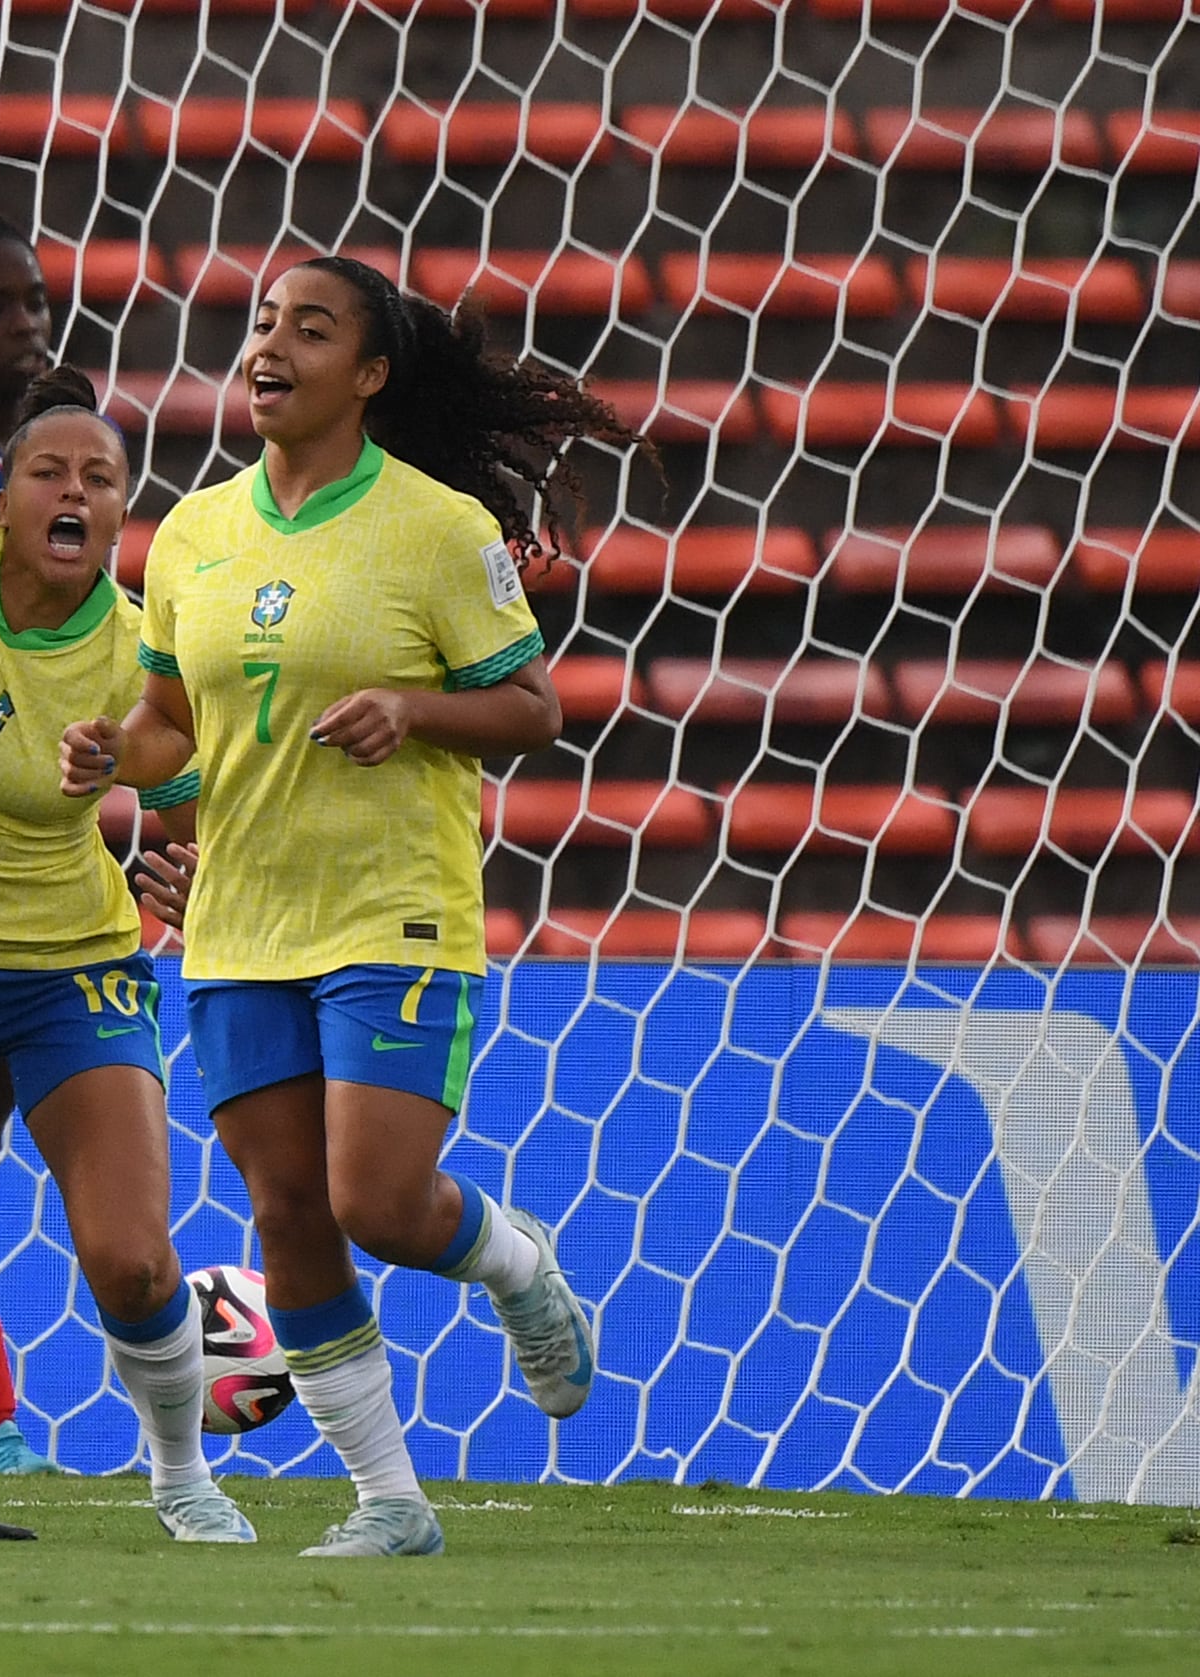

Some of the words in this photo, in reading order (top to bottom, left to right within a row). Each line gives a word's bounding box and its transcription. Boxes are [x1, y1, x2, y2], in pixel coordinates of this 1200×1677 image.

[244, 633, 284, 643] BRASIL
[243, 662, 280, 744] 7
[72, 969, 140, 1017] 10
